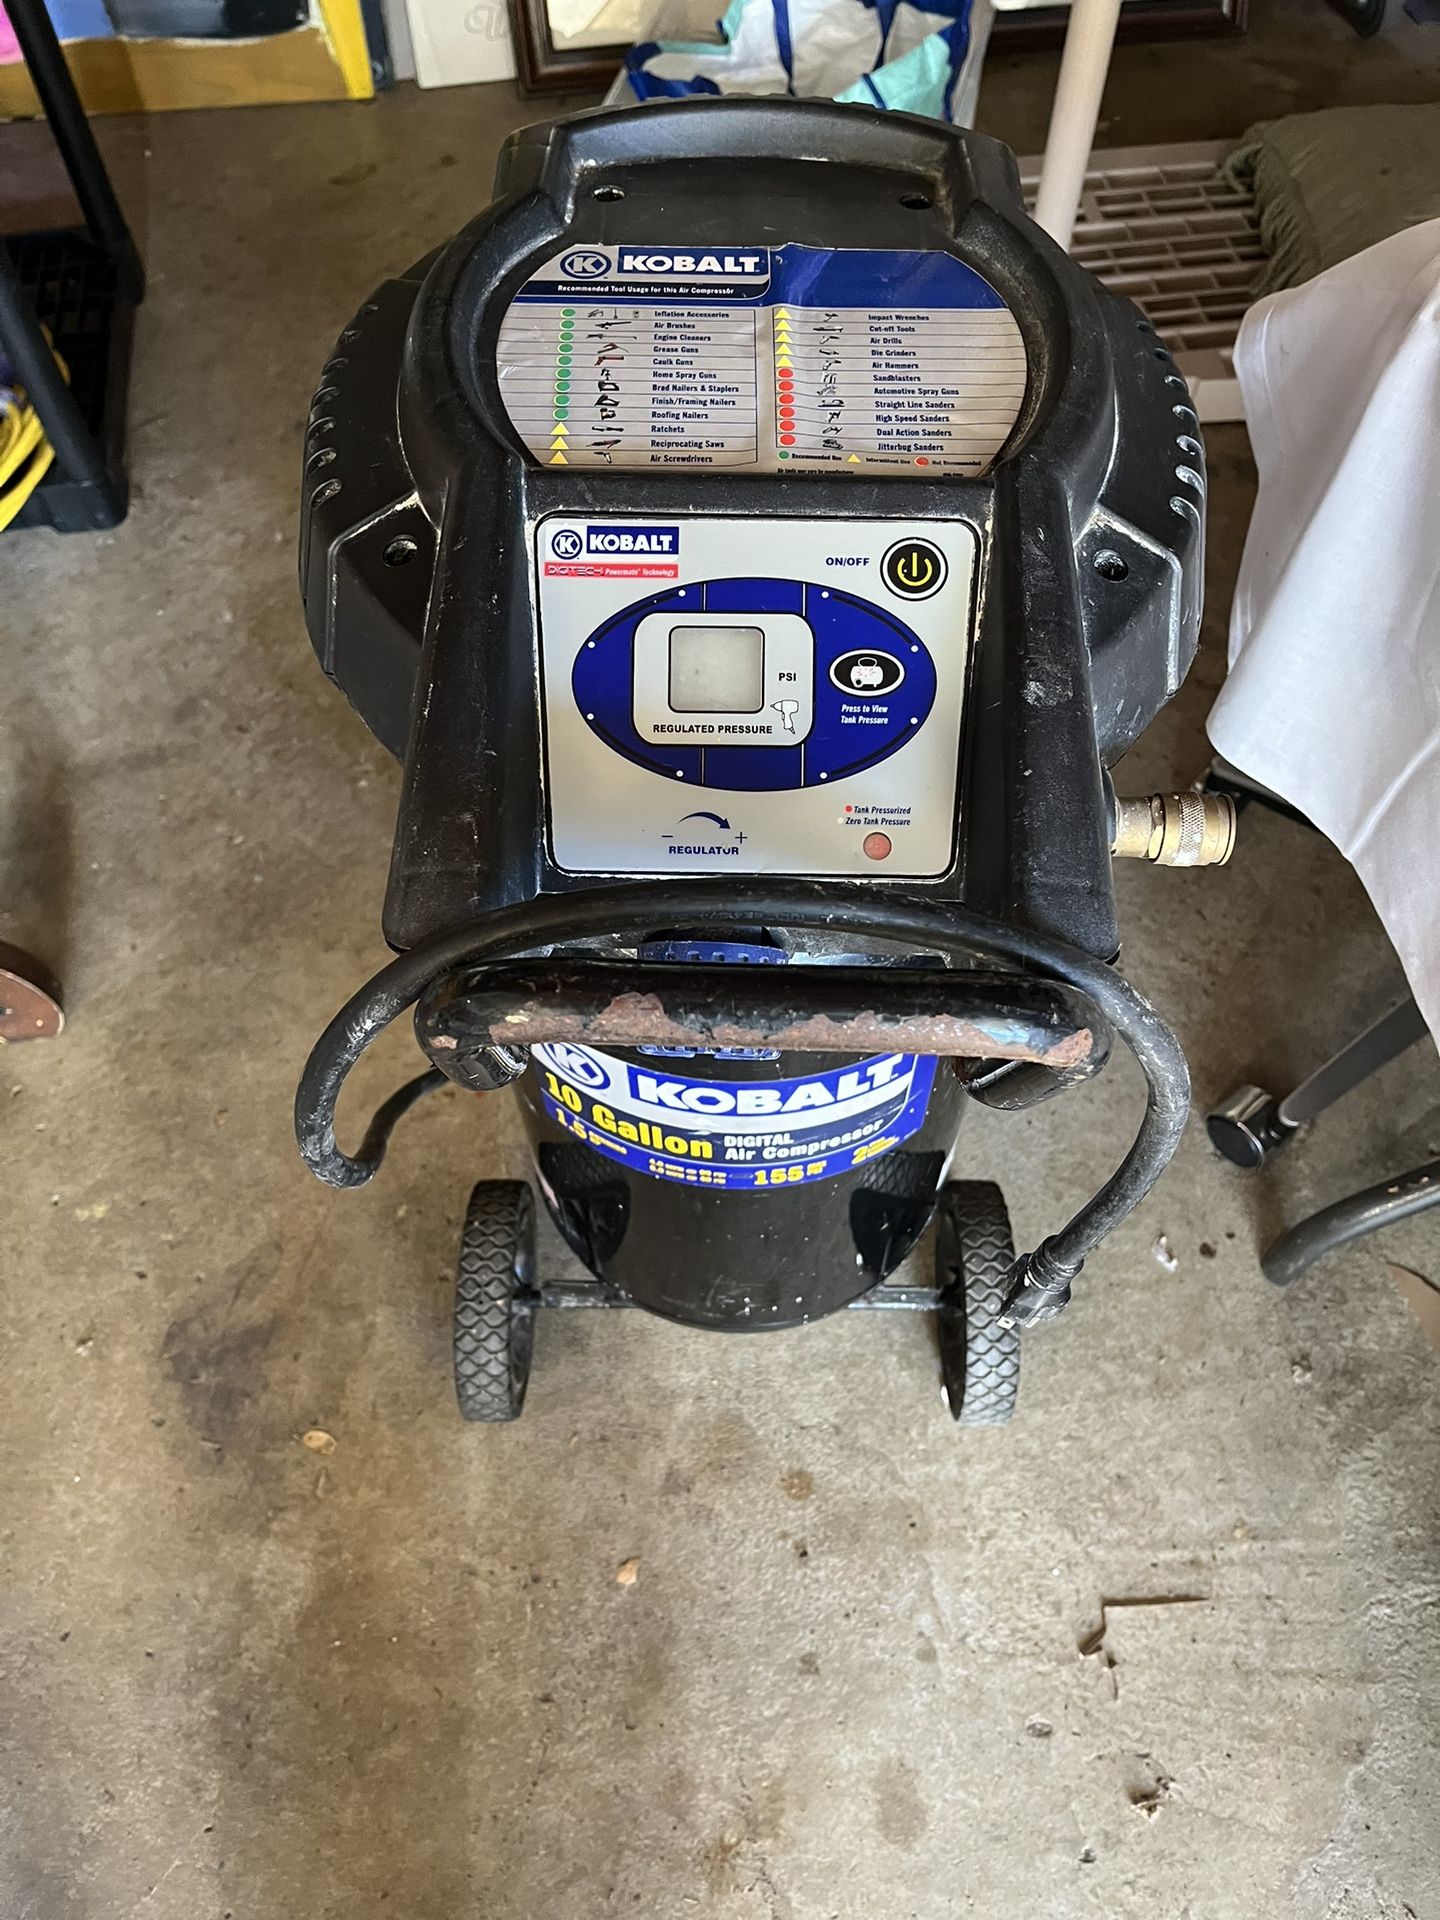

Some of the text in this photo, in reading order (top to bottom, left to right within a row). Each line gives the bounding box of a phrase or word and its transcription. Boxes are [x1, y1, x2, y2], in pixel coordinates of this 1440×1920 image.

[573, 256, 599, 273] K
[623, 255, 760, 272] KOBALT
[628, 286, 649, 294] Usage
[676, 371, 696, 379] Spray
[652, 397, 707, 406] Finish/Framing
[875, 401, 905, 409] Straight
[652, 411, 680, 420] Roofing
[651, 440, 703, 449] Reciprocating
[878, 443, 911, 452] Jitterbug
[590, 534, 672, 551] KOBALT
[825, 557, 870, 567] ON/OFF
[642, 568, 674, 577] Technology
[778, 672, 797, 682] PSI
[842, 704, 861, 712] Press
[841, 716, 888, 724] Tank Pressure
[653, 724, 773, 734] REGULATED PRESSURE
[871, 806, 911, 814] Pressurized
[668, 846, 739, 855] REGULATOR
[636, 1053, 903, 1114] KOBALT
[545, 1072, 582, 1113] 10
[592, 1104, 713, 1159] Gallon
[556, 1108, 587, 1139] 1.5
[724, 1133, 794, 1148] DIGITAL
[725, 1148, 756, 1160] Air
[762, 1119, 884, 1160] Compressor
[754, 1166, 804, 1185] 155
